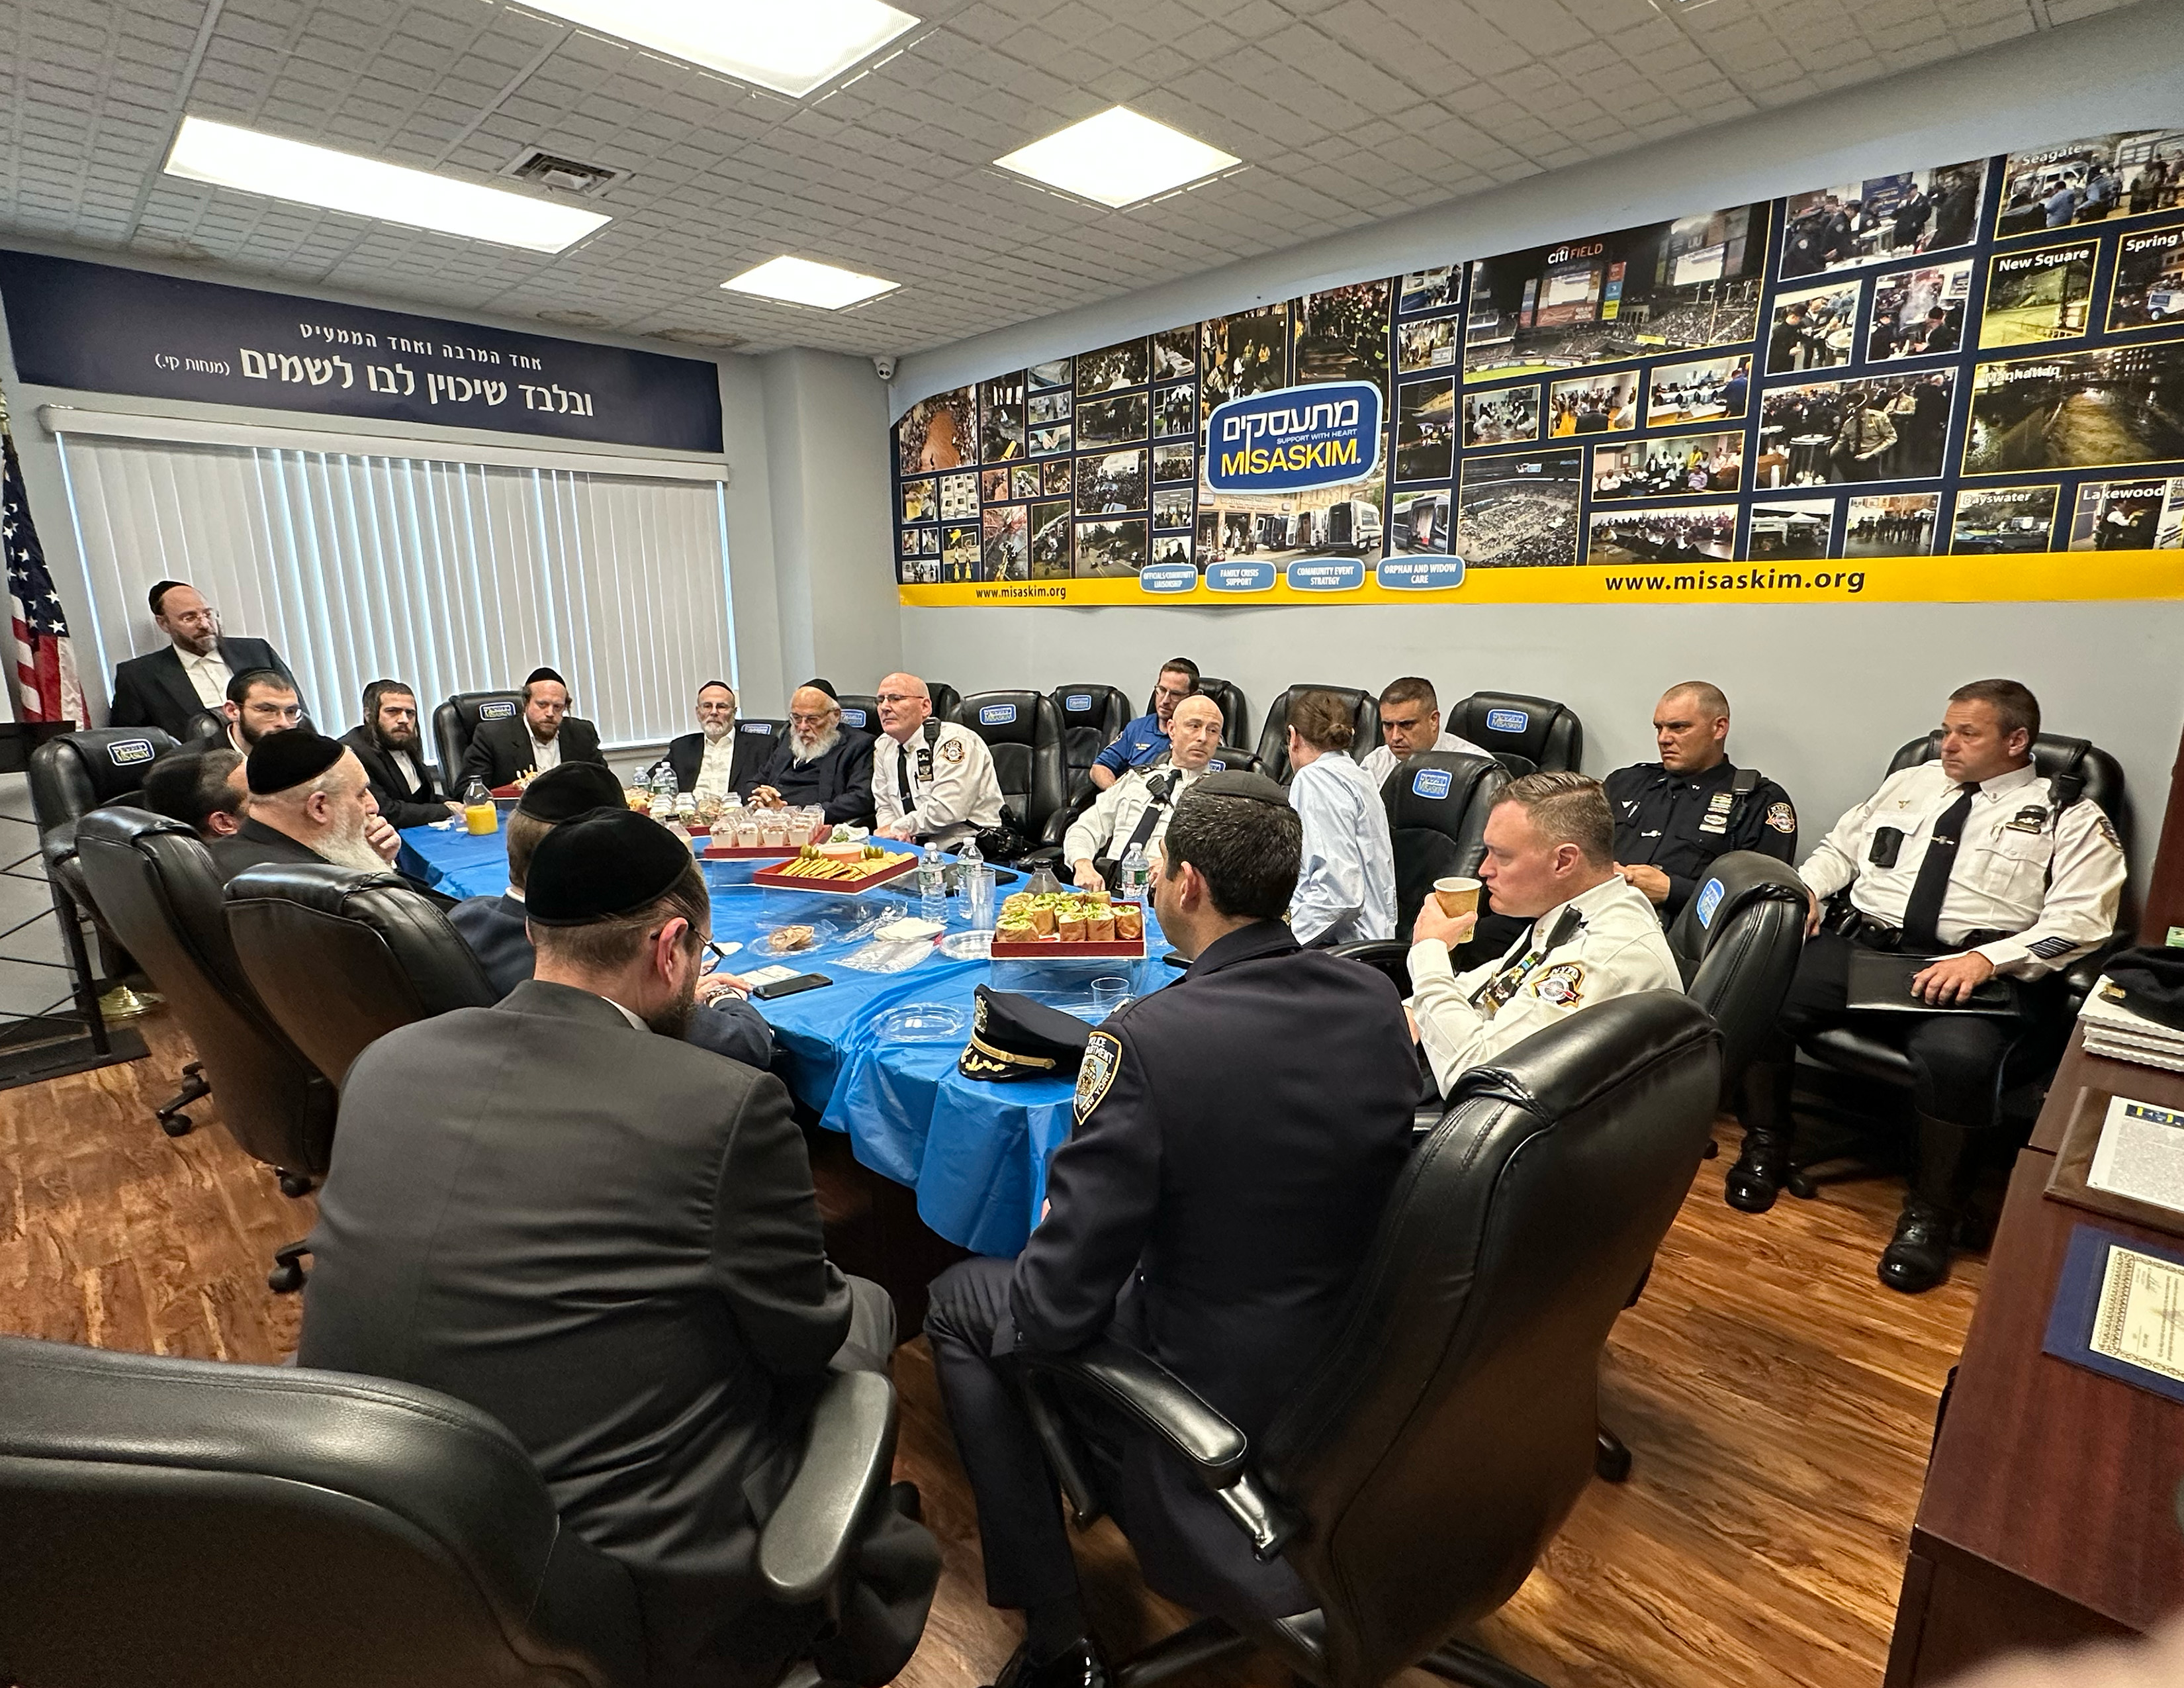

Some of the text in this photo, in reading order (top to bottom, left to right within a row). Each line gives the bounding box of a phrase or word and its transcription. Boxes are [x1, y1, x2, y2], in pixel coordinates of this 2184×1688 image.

[2022, 145, 2082, 165] Seagate
[2125, 234, 2178, 252] Spring
[1547, 244, 1603, 264] citi FIELD
[1999, 250, 2089, 272] New Square
[300, 324, 541, 371] אחד המרבה ואחד הממעיט
[240, 348, 353, 389] לשמים
[1985, 365, 2061, 383] Manhattan
[367, 363, 415, 396] לבו
[427, 373, 508, 406] שיכוין
[518, 384, 594, 416] ובלבד
[1223, 400, 1359, 450] מתעסקים
[1277, 429, 1357, 445] SUPPORT WITH HEART
[1964, 493, 2032, 506] Bayswater
[2083, 485, 2165, 500] Lakewood
[1297, 566, 1354, 576] COMMUNITY EVENT
[1385, 563, 1457, 574] ORPHAN AND WIDOW
[1310, 577, 1340, 585] STRATEGY
[1411, 575, 1429, 584] CARE
[1605, 568, 1865, 593] www.misaskim.org
[976, 585, 1066, 600] www.misaskim.org
[1551, 966, 1579, 980] NYPD
[1082, 1071, 1111, 1113] NEW YORK
